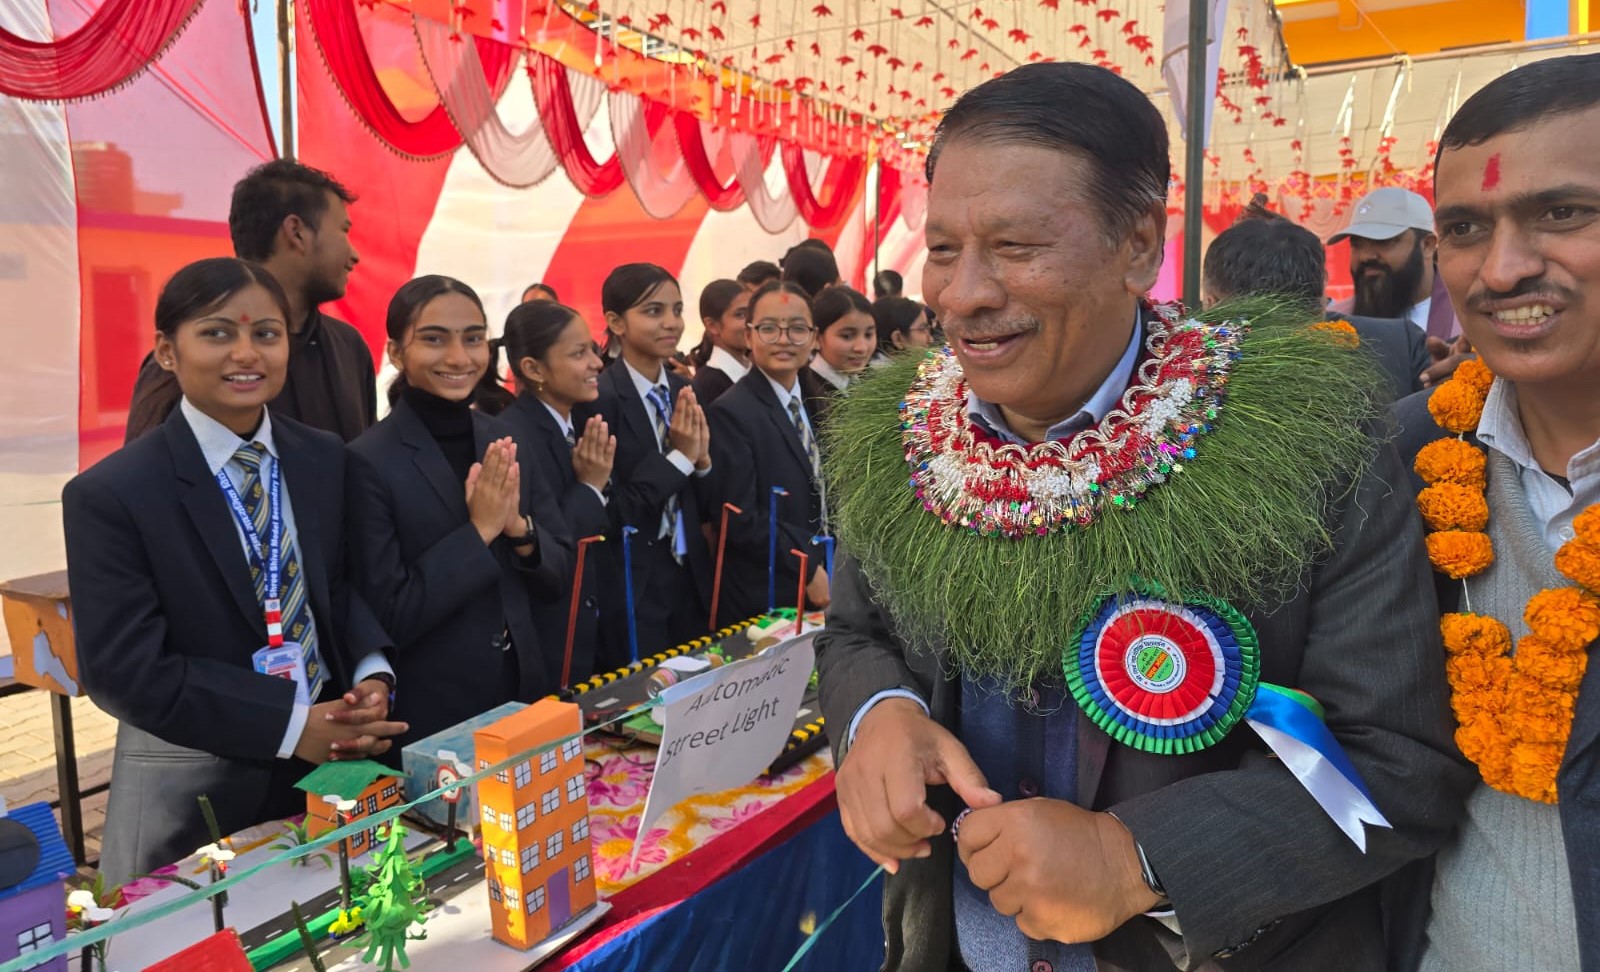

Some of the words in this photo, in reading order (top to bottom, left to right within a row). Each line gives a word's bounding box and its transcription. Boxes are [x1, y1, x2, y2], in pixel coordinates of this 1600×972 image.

[272, 480, 280, 520] Secondary
[271, 521, 280, 547] Model
[269, 548, 279, 572] Shiva
[269, 573, 278, 599] Shree
[684, 658, 790, 716] Automatic
[730, 696, 780, 734] Light
